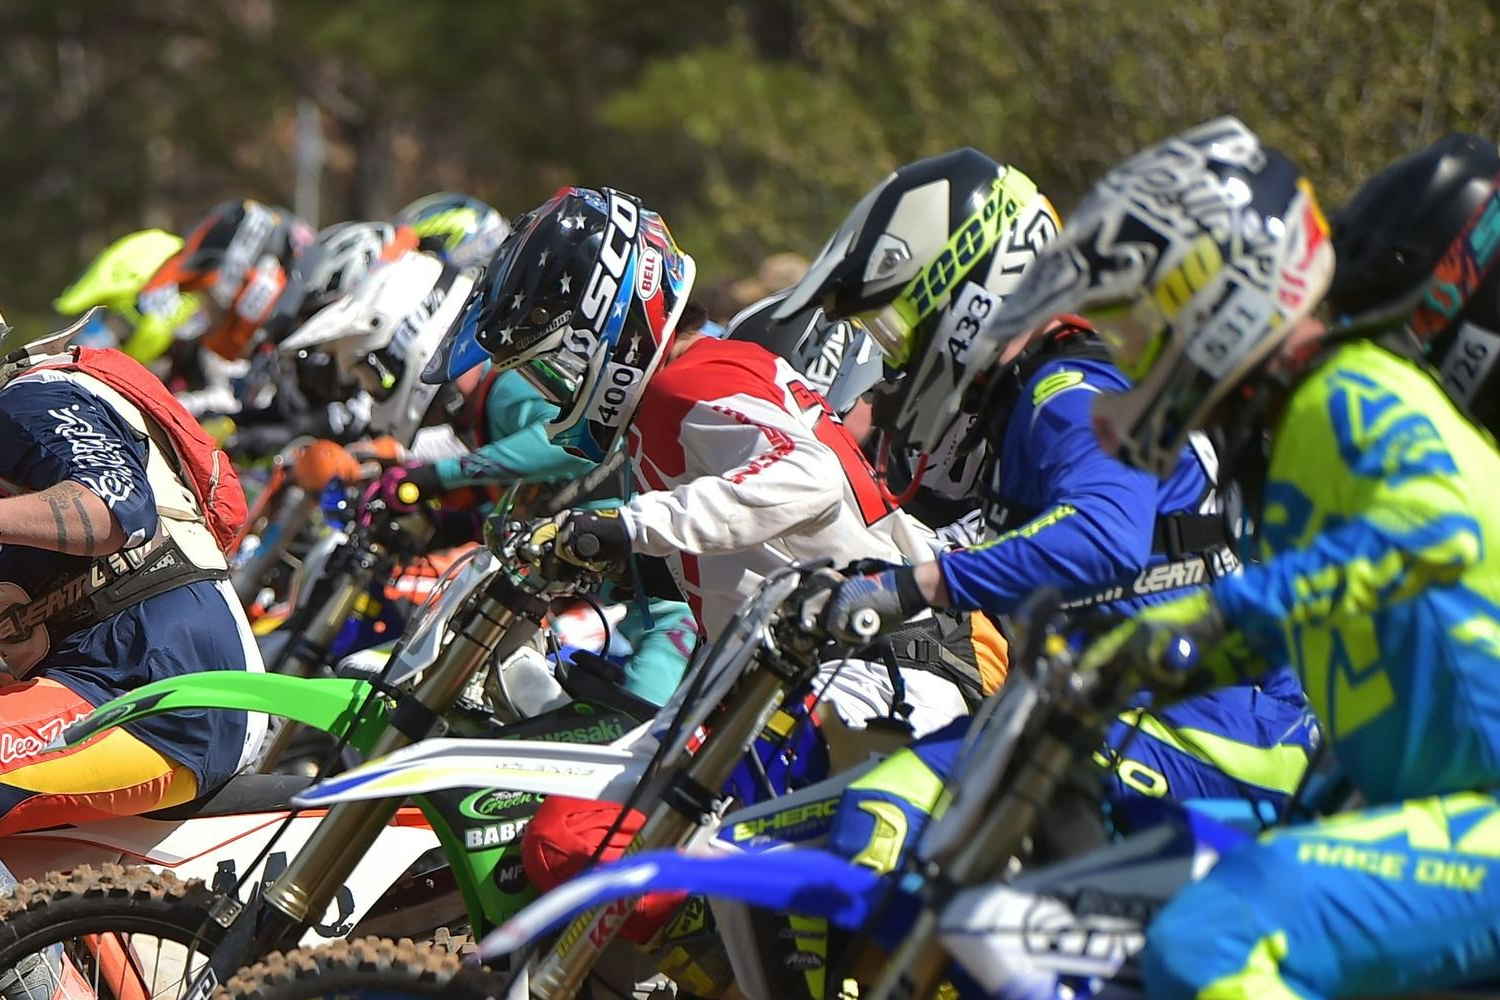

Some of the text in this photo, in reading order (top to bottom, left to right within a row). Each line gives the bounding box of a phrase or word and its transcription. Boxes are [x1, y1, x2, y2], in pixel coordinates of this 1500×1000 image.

[641, 256, 656, 292] BELL
[907, 187, 1017, 317] 100%
[948, 294, 992, 359] 433
[1445, 340, 1490, 395] 726
[597, 367, 635, 425] 400
[0, 733, 43, 764] Lee
[478, 794, 533, 815] Green
[1297, 842, 1406, 880] RACE
